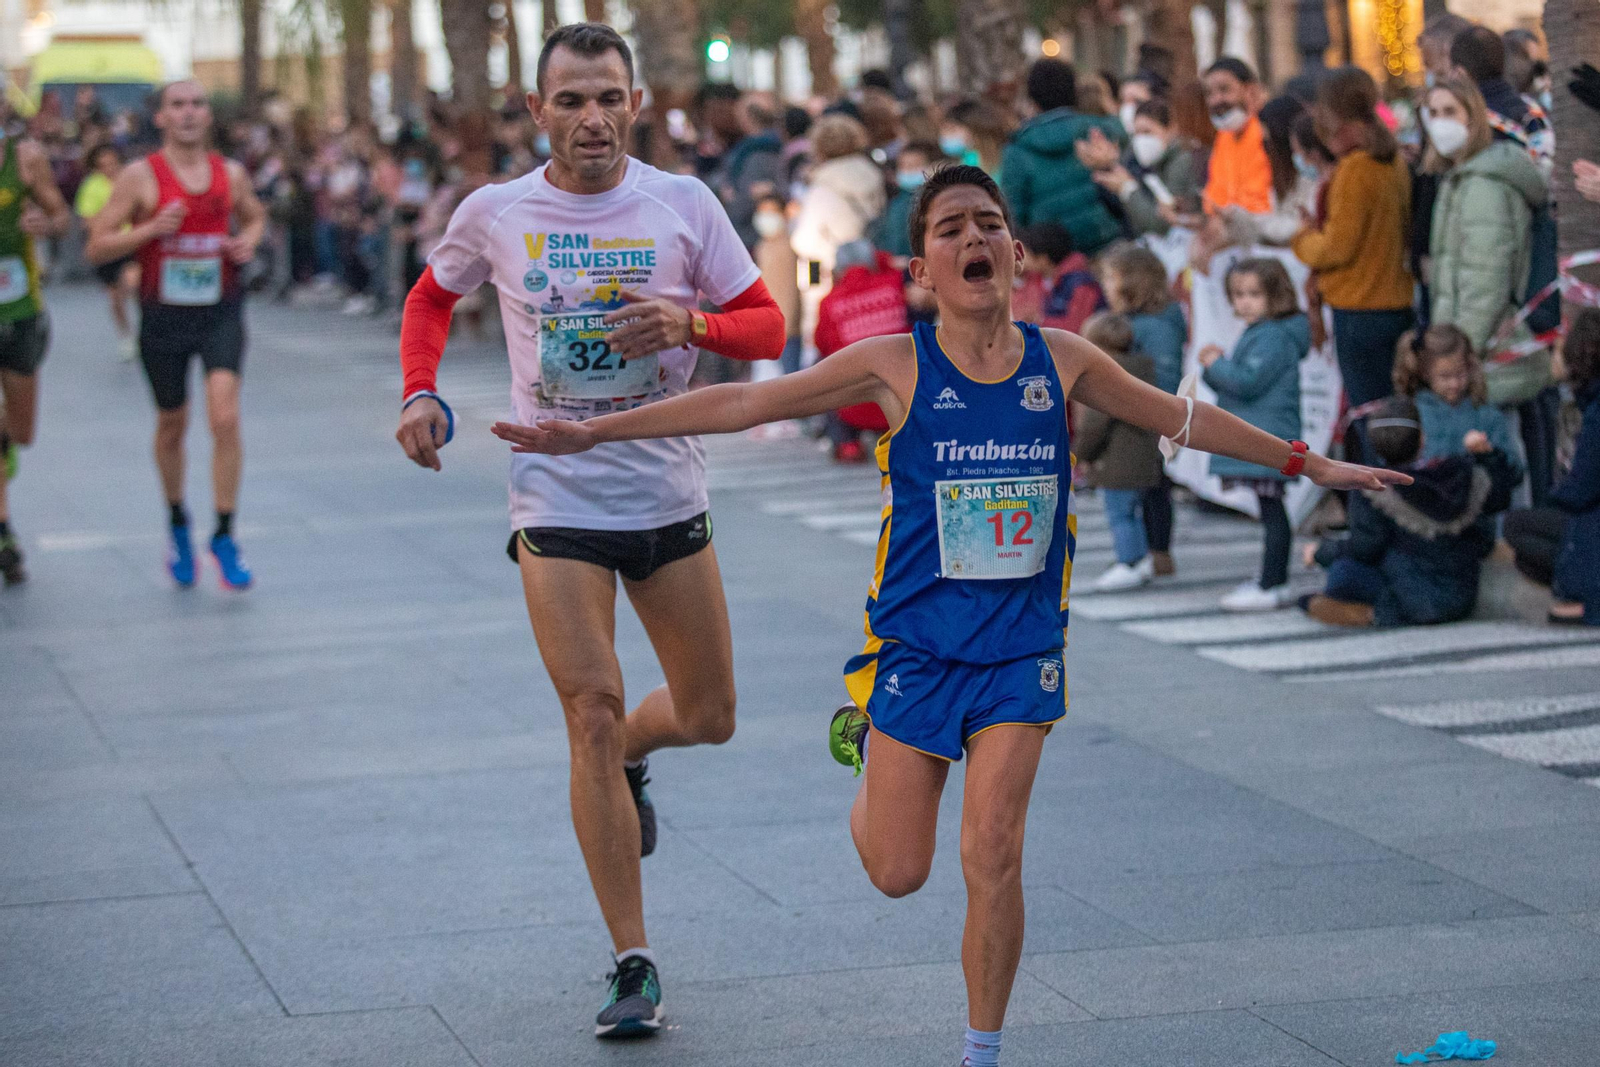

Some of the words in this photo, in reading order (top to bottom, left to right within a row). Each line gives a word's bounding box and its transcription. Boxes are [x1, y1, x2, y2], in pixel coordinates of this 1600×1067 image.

[523, 232, 547, 260] V
[548, 233, 590, 250] SAN
[548, 250, 656, 269] SILVESTRE
[549, 320, 557, 331] V
[560, 318, 584, 331] SAN
[578, 331, 610, 339] Gadita
[933, 401, 967, 410] austral
[933, 438, 1056, 462] Tirabuzón
[962, 467, 986, 475] Piedra
[988, 466, 1020, 475] Pikachos
[1029, 466, 1044, 475] 1982
[950, 487, 960, 501] V
[963, 486, 992, 500] SAN
[995, 482, 1055, 499] SILVESTRE
[985, 500, 1029, 510] Gaditana
[987, 510, 1034, 547] 12
[997, 551, 1023, 559] MARTIN
